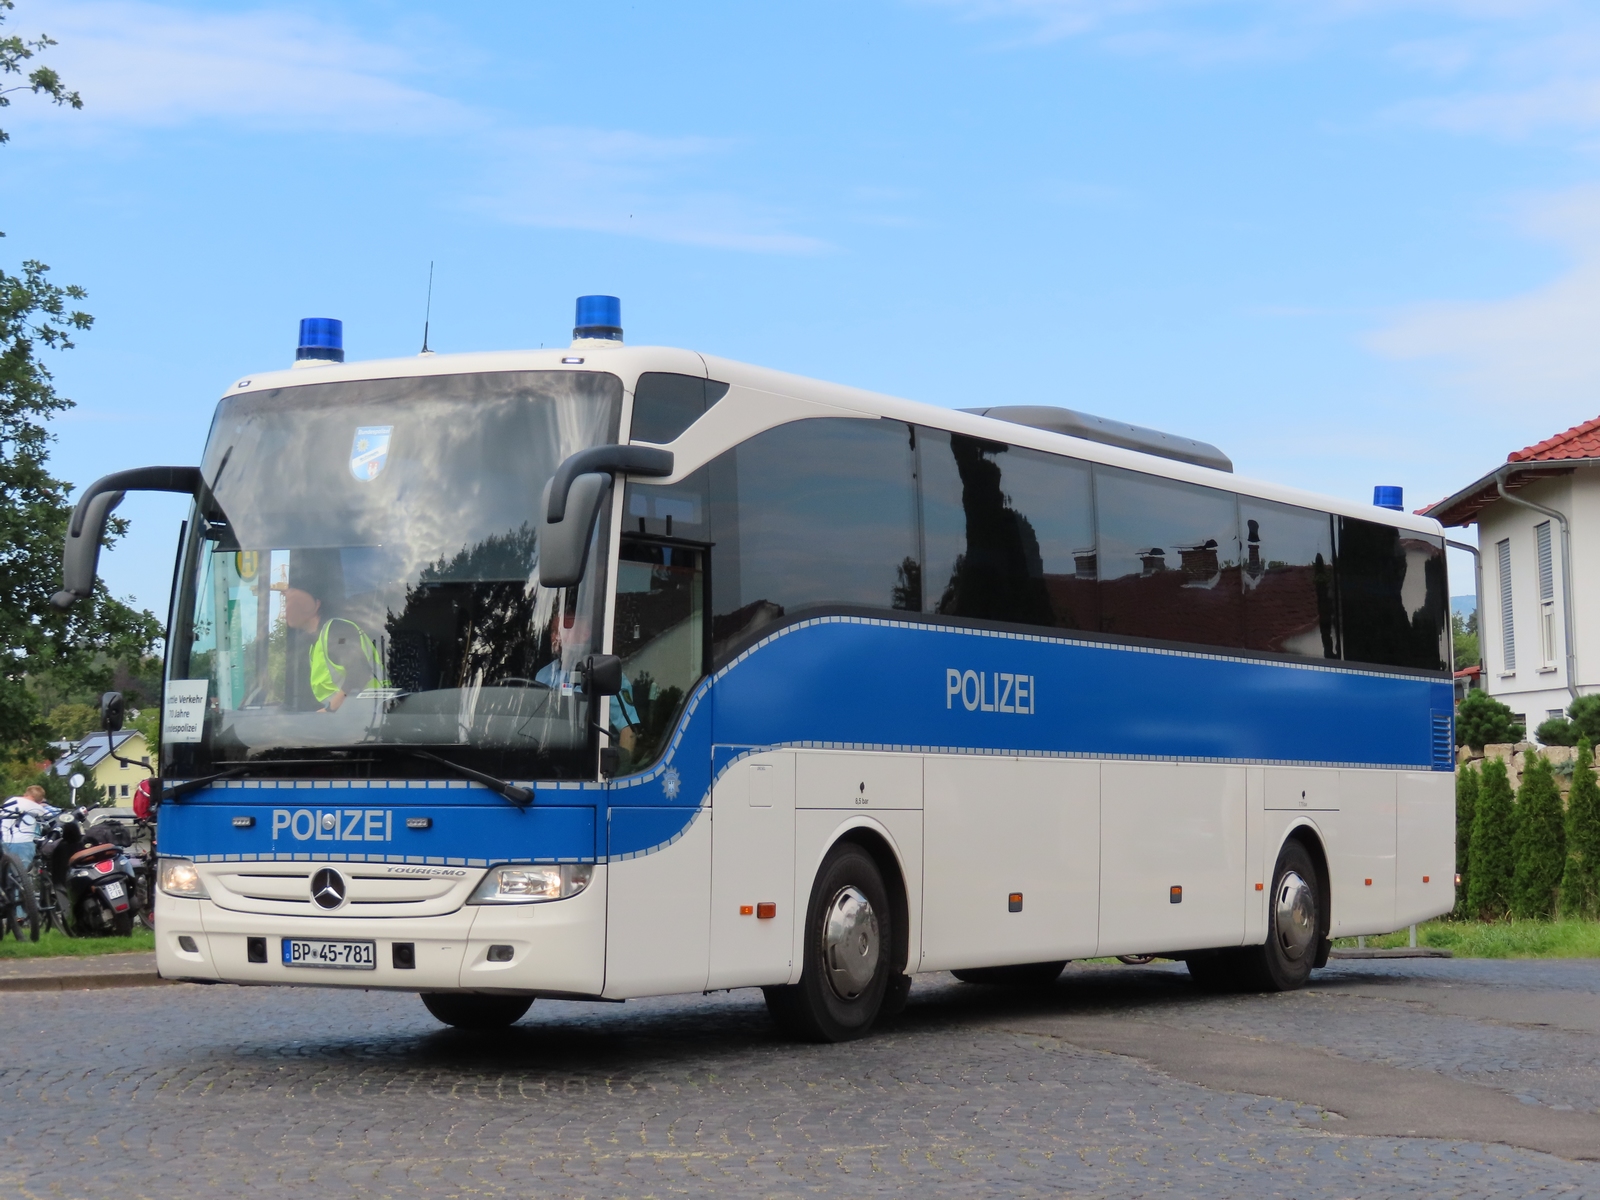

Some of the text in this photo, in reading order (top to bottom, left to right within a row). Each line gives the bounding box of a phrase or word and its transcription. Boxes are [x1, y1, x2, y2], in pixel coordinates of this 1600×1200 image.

[179, 694, 202, 704] Verkehr
[946, 668, 1035, 715] POLIZEI
[174, 708, 190, 718] Jahre
[272, 809, 392, 842] POLIZEI
[386, 866, 467, 876] TOURISMO
[292, 943, 311, 961] BP
[319, 944, 372, 964] 45-781
